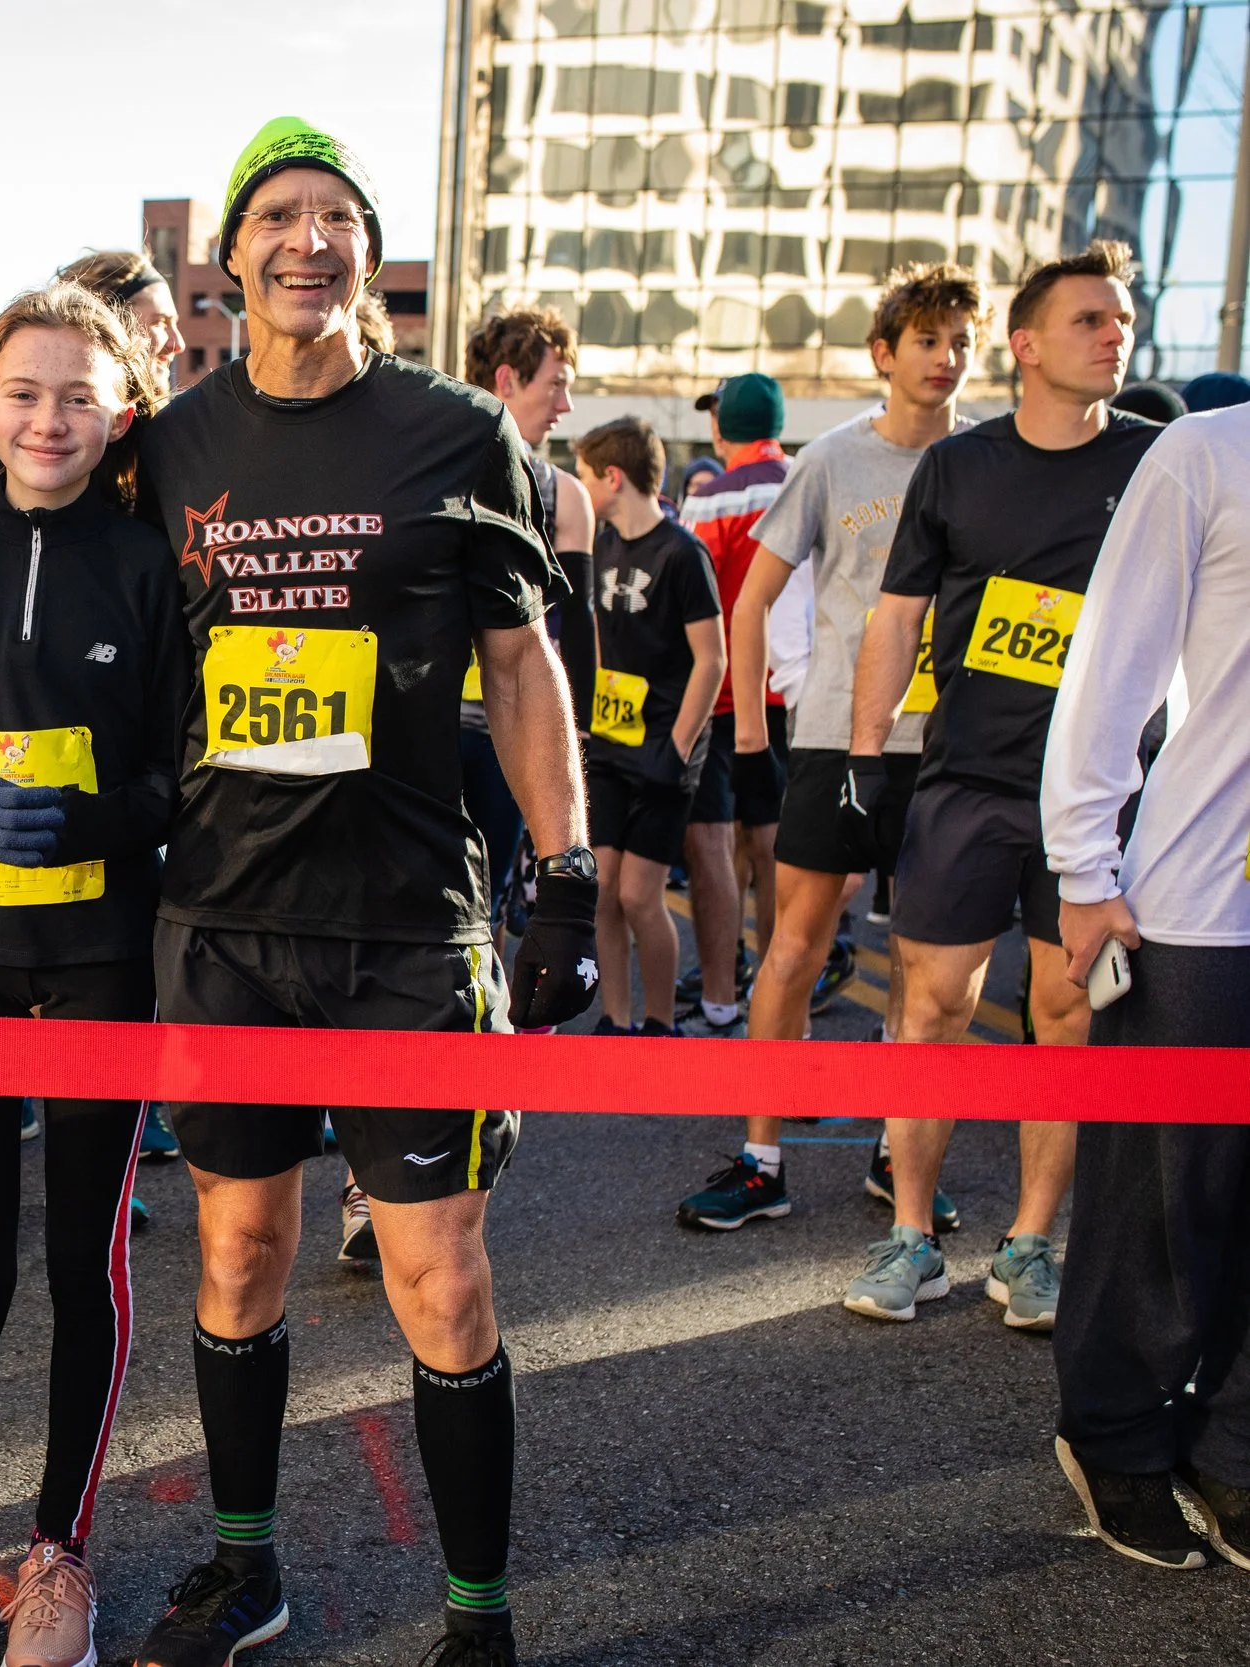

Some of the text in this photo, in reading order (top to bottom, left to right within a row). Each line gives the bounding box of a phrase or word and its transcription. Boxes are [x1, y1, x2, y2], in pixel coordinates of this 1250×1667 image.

[202, 512, 385, 549] ROANOKE
[216, 548, 364, 580] VALLEY
[227, 585, 352, 615] ELITE
[218, 683, 347, 746] 2561
[596, 693, 635, 723] 1213
[418, 1358, 504, 1389] ZENSAH
